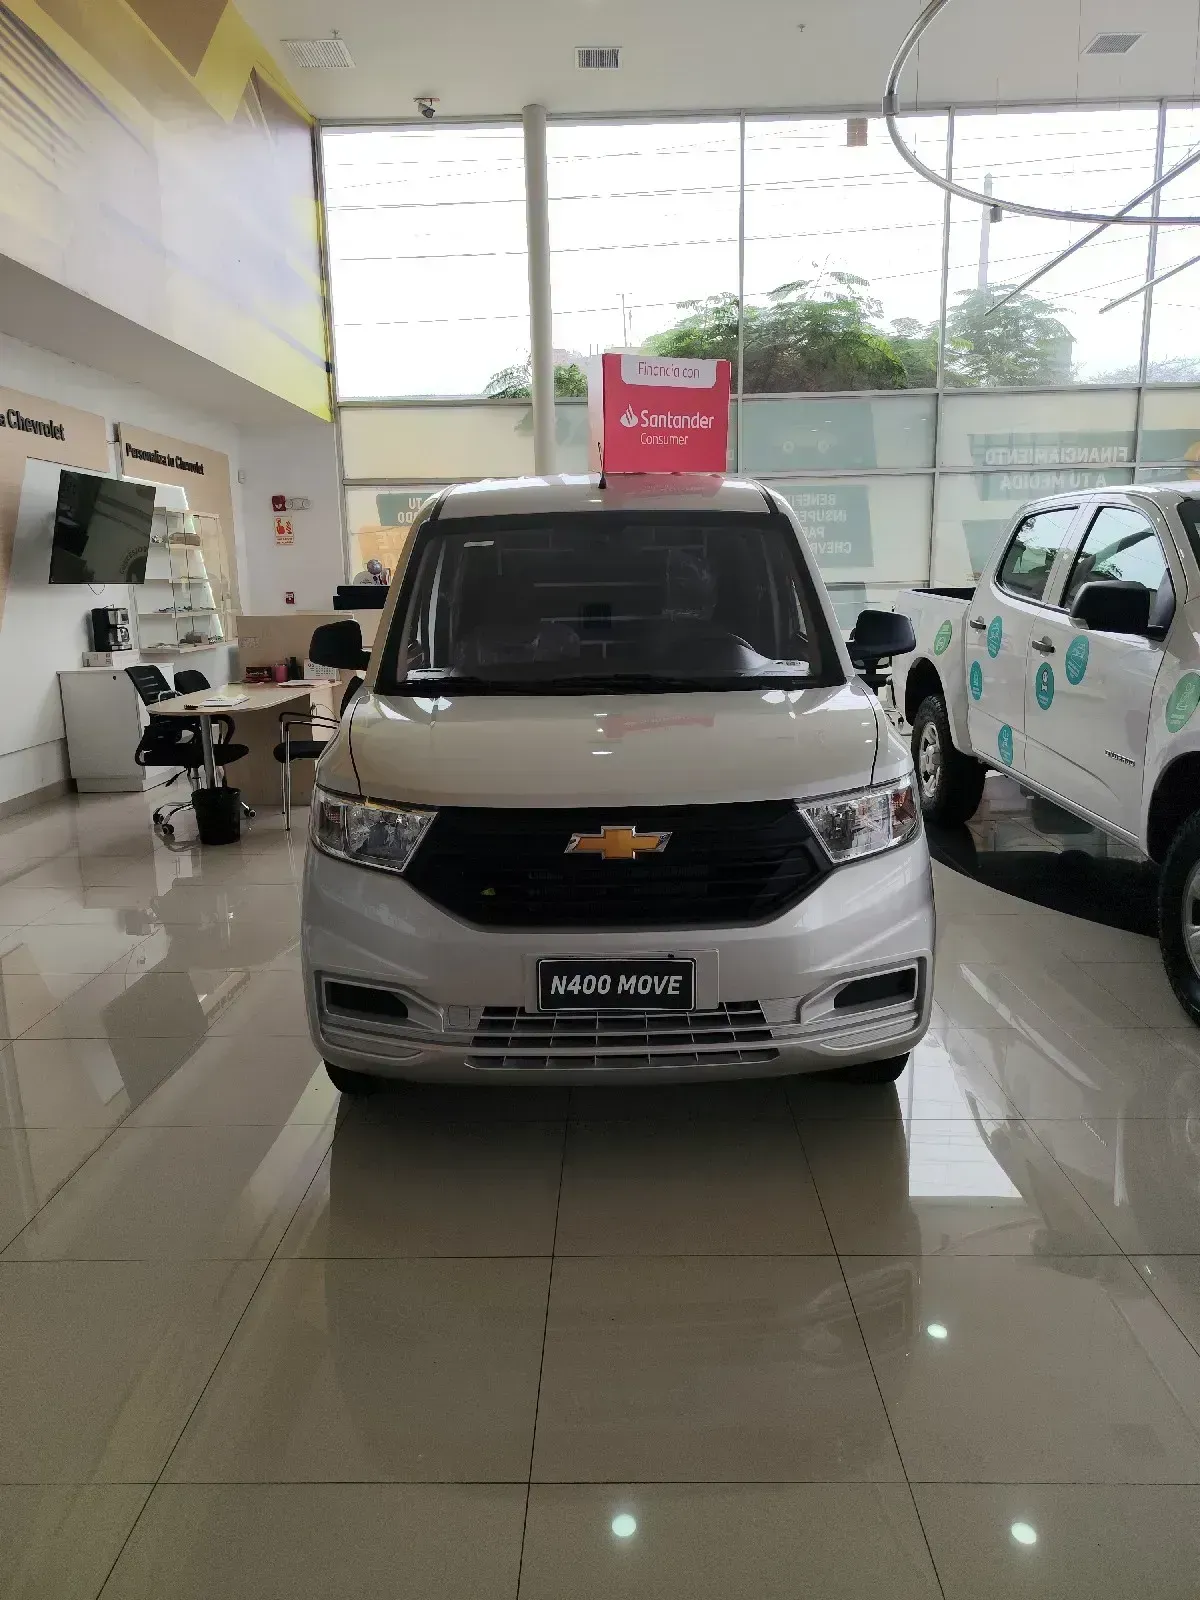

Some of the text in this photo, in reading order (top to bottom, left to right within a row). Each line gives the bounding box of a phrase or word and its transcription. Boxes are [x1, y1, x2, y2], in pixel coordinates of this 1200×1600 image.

[638, 361, 701, 379] Financia con
[7, 408, 66, 441] Chevrolet
[640, 409, 715, 429] Santander
[640, 432, 689, 446] Consumer
[126, 442, 205, 476] Personaliza tu Chevrolet
[550, 974, 683, 995] N400 MOVE
